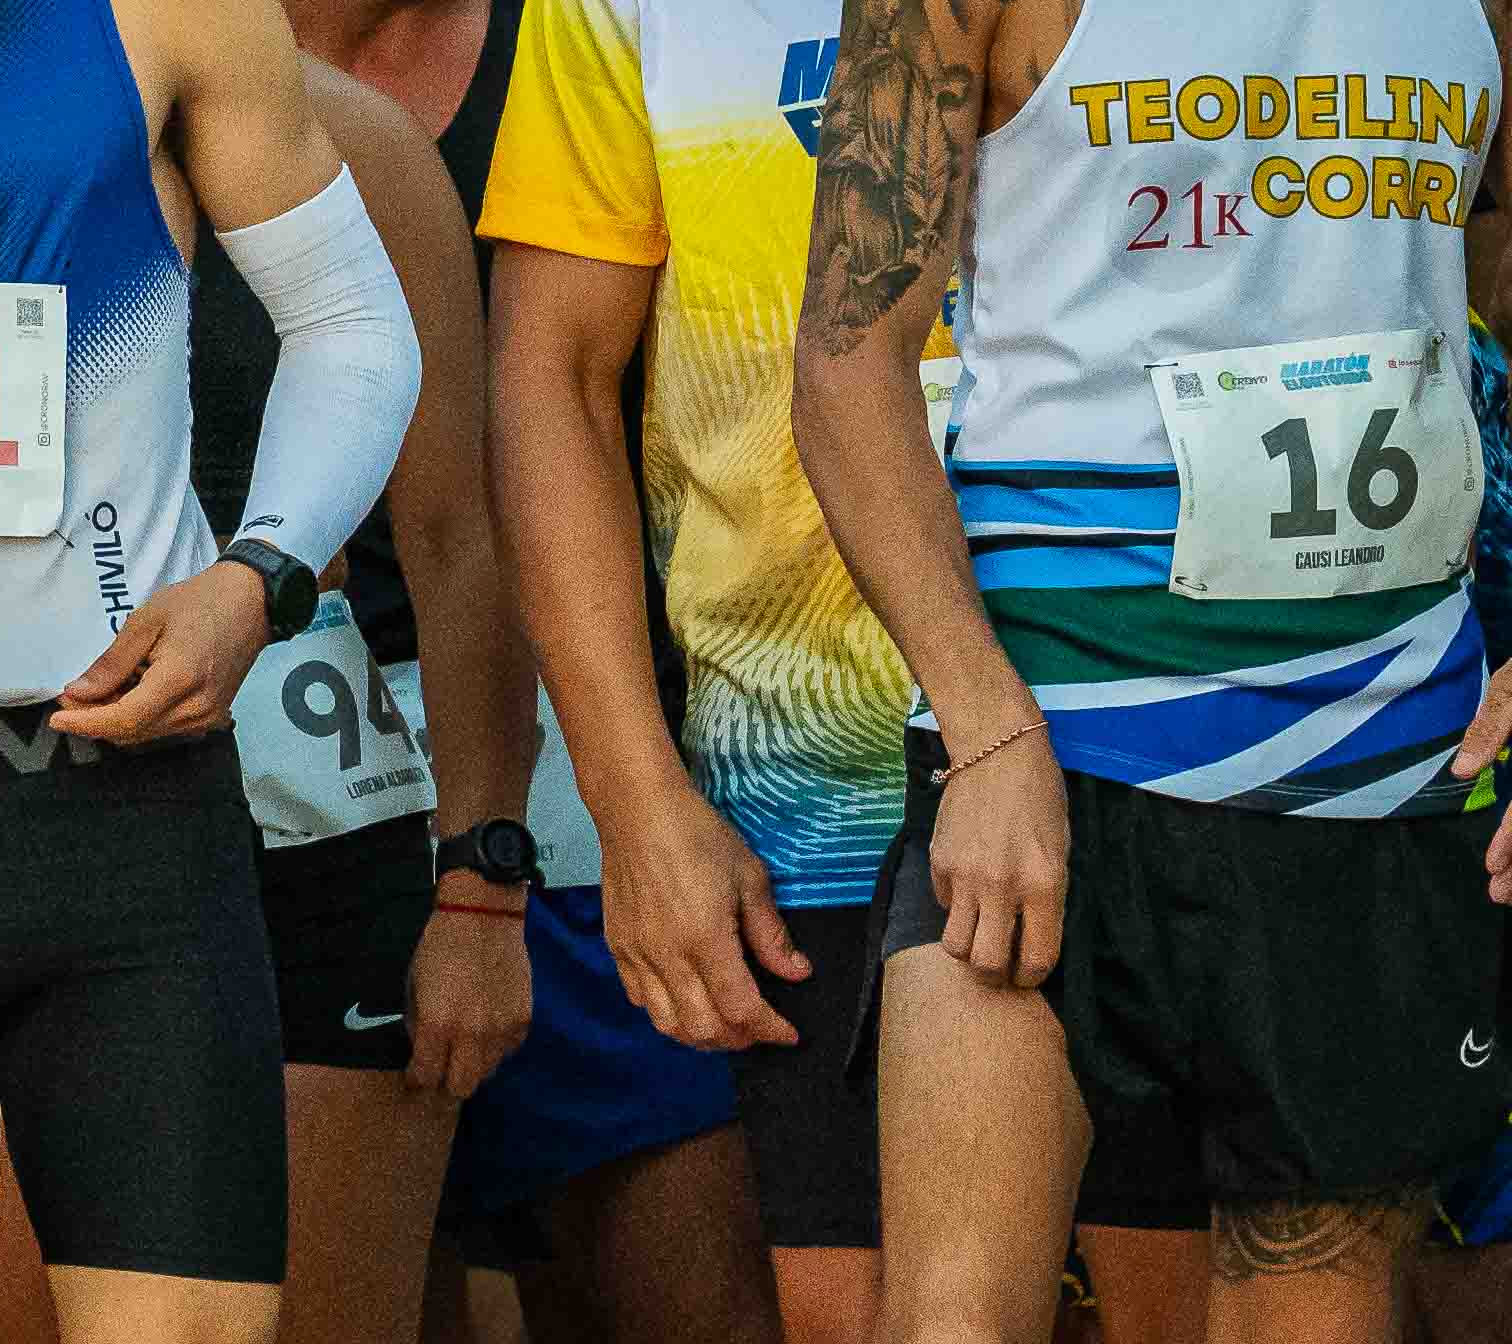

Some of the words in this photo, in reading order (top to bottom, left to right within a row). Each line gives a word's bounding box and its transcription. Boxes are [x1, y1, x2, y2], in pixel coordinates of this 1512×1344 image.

[1250, 154, 1466, 229] CORR
[1260, 407, 1419, 540] 16
[1295, 551, 1333, 570] CAUSI
[1334, 544, 1386, 567] LEANDRO
